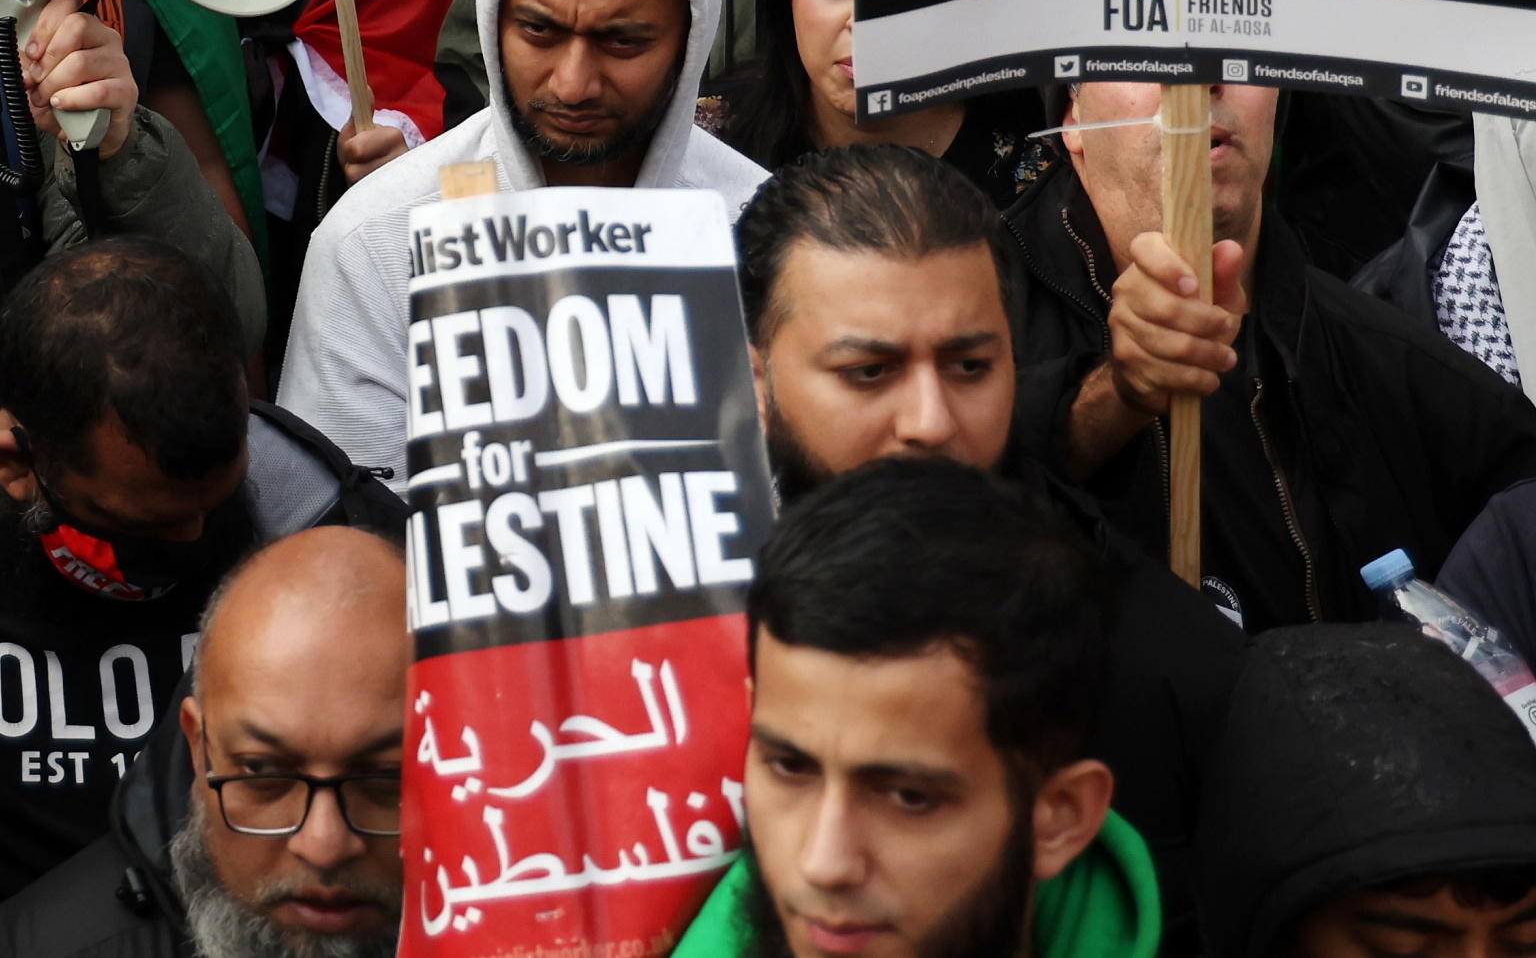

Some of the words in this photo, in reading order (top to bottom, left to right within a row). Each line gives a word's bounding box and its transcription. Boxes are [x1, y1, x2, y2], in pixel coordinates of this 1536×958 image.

[1187, 17, 1204, 33] OF
[1210, 18, 1272, 37] AL-AQSA
[898, 66, 1026, 104] foapeaceinpalestine
[1086, 59, 1193, 75] friendsofalaqsa
[1255, 64, 1364, 87] friendsofalaqsa
[483, 209, 653, 262] Worker
[462, 430, 531, 489] for
[1202, 579, 1238, 609] PALESTINE
[415, 657, 688, 801] الحرية
[21, 750, 90, 783] EST
